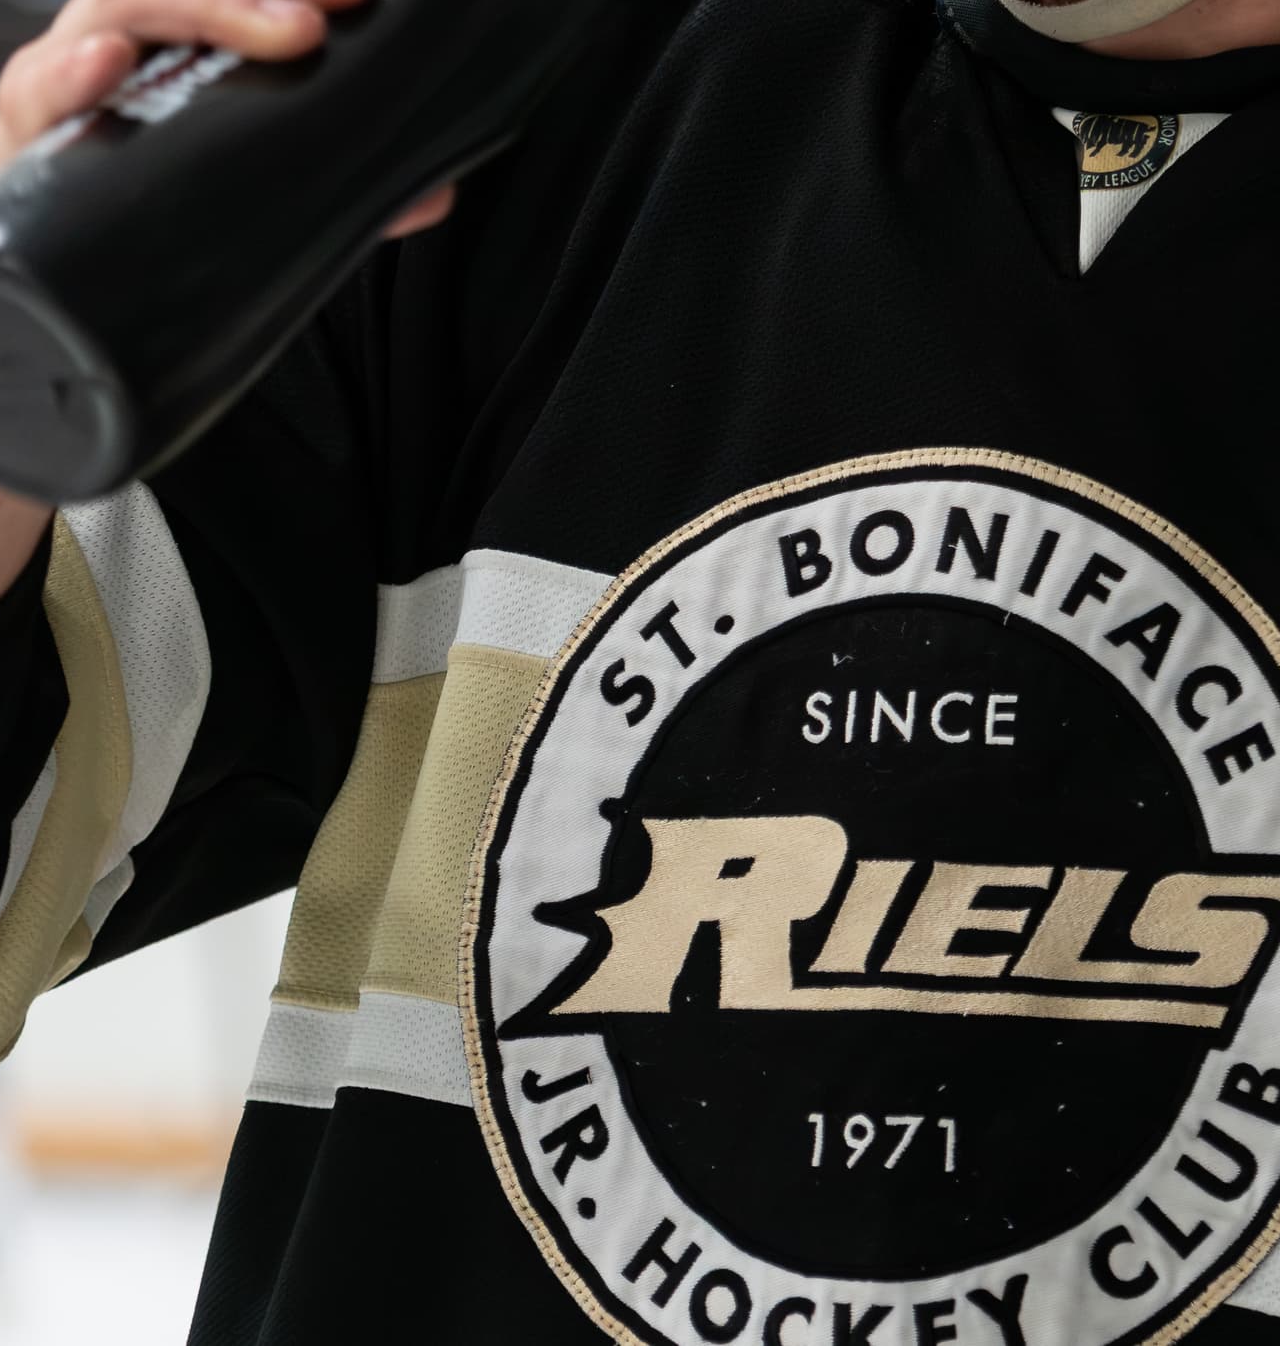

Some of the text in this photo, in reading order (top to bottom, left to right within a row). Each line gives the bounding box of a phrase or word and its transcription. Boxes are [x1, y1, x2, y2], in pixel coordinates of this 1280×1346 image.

[1104, 158, 1158, 187] LEAGUE
[599, 506, 1278, 786] ST. BONIFACE
[800, 690, 1021, 747] SINCE
[806, 1111, 958, 1174] 1971
[520, 1065, 611, 1221] JR.
[620, 1216, 1030, 1346] HOCKEY
